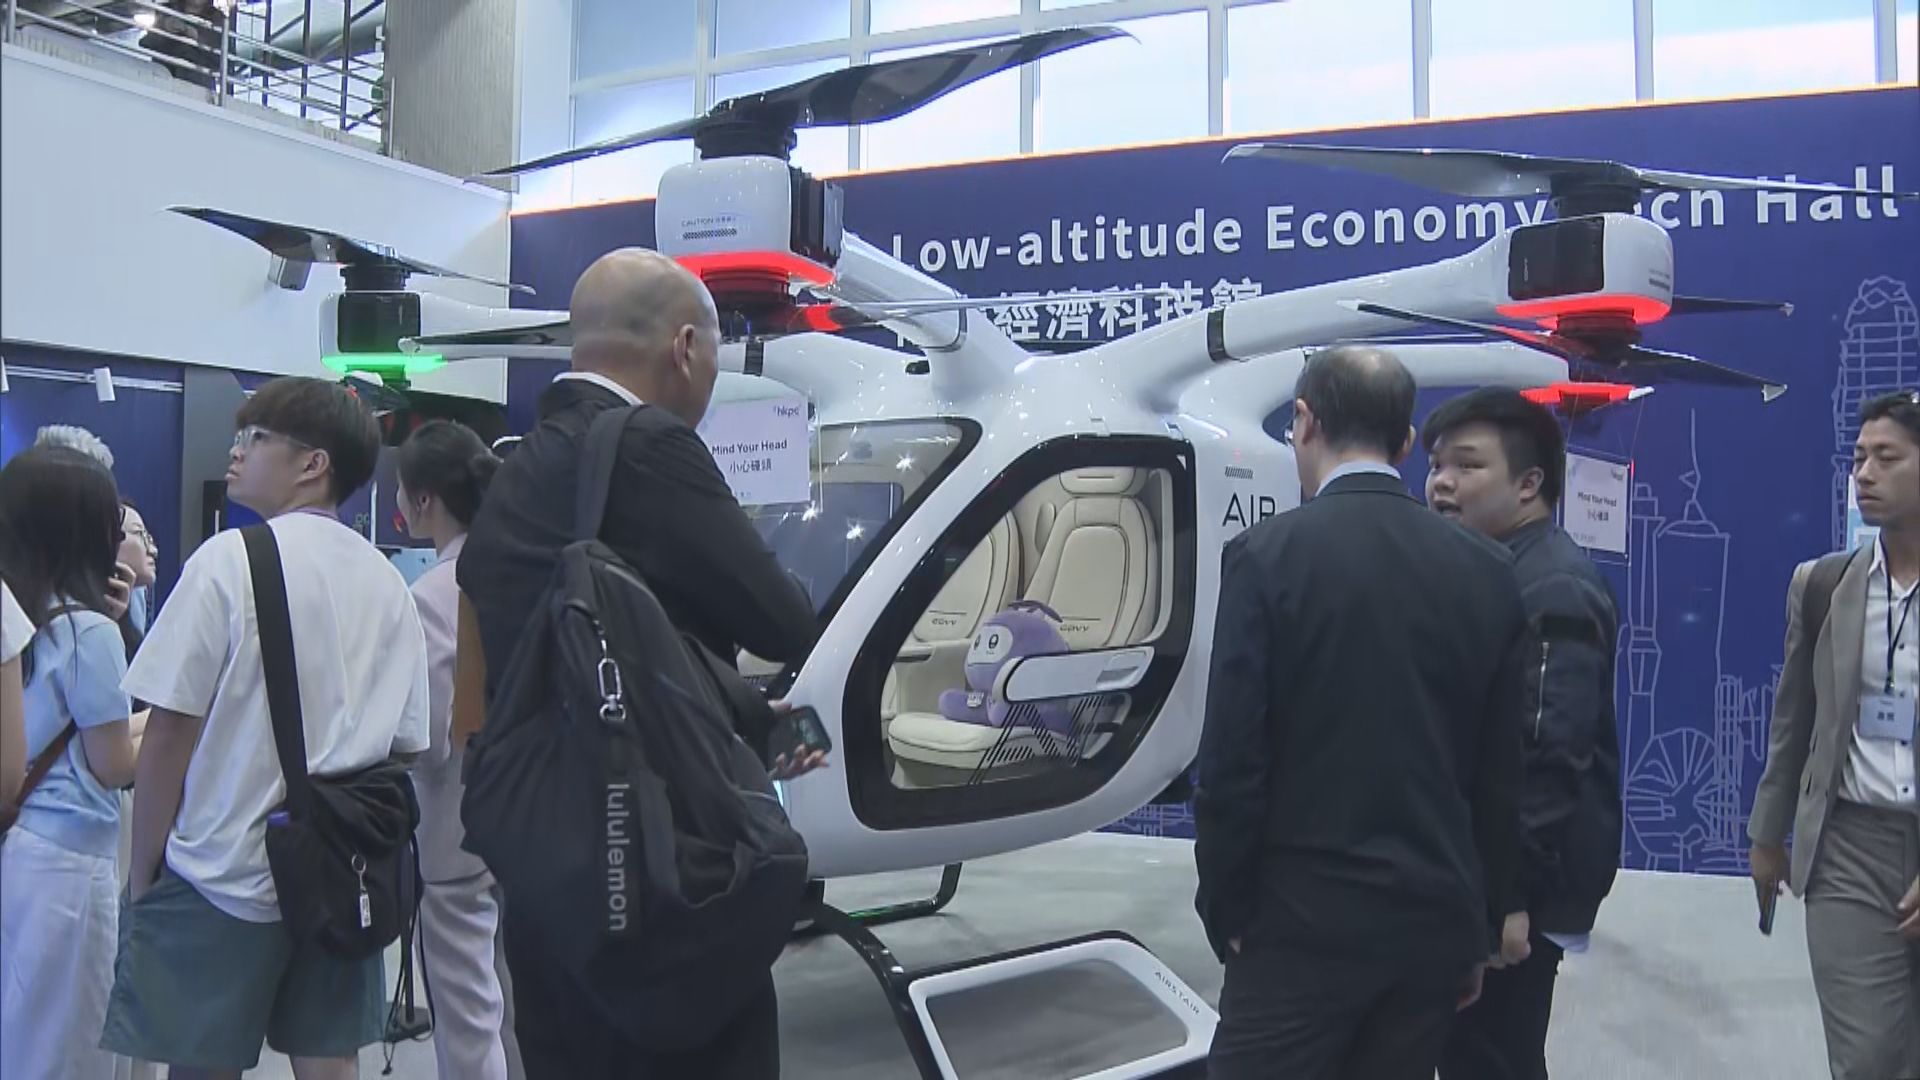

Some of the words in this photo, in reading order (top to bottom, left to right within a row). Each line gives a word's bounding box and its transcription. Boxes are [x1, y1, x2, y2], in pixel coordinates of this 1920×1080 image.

[1266, 199, 1548, 250] Economy
[1756, 166, 1899, 224] Hall
[711, 444, 735, 455] Mind
[737, 442, 759, 453] Your
[761, 438, 787, 451] Head
[607, 783, 628, 931] lululemon
